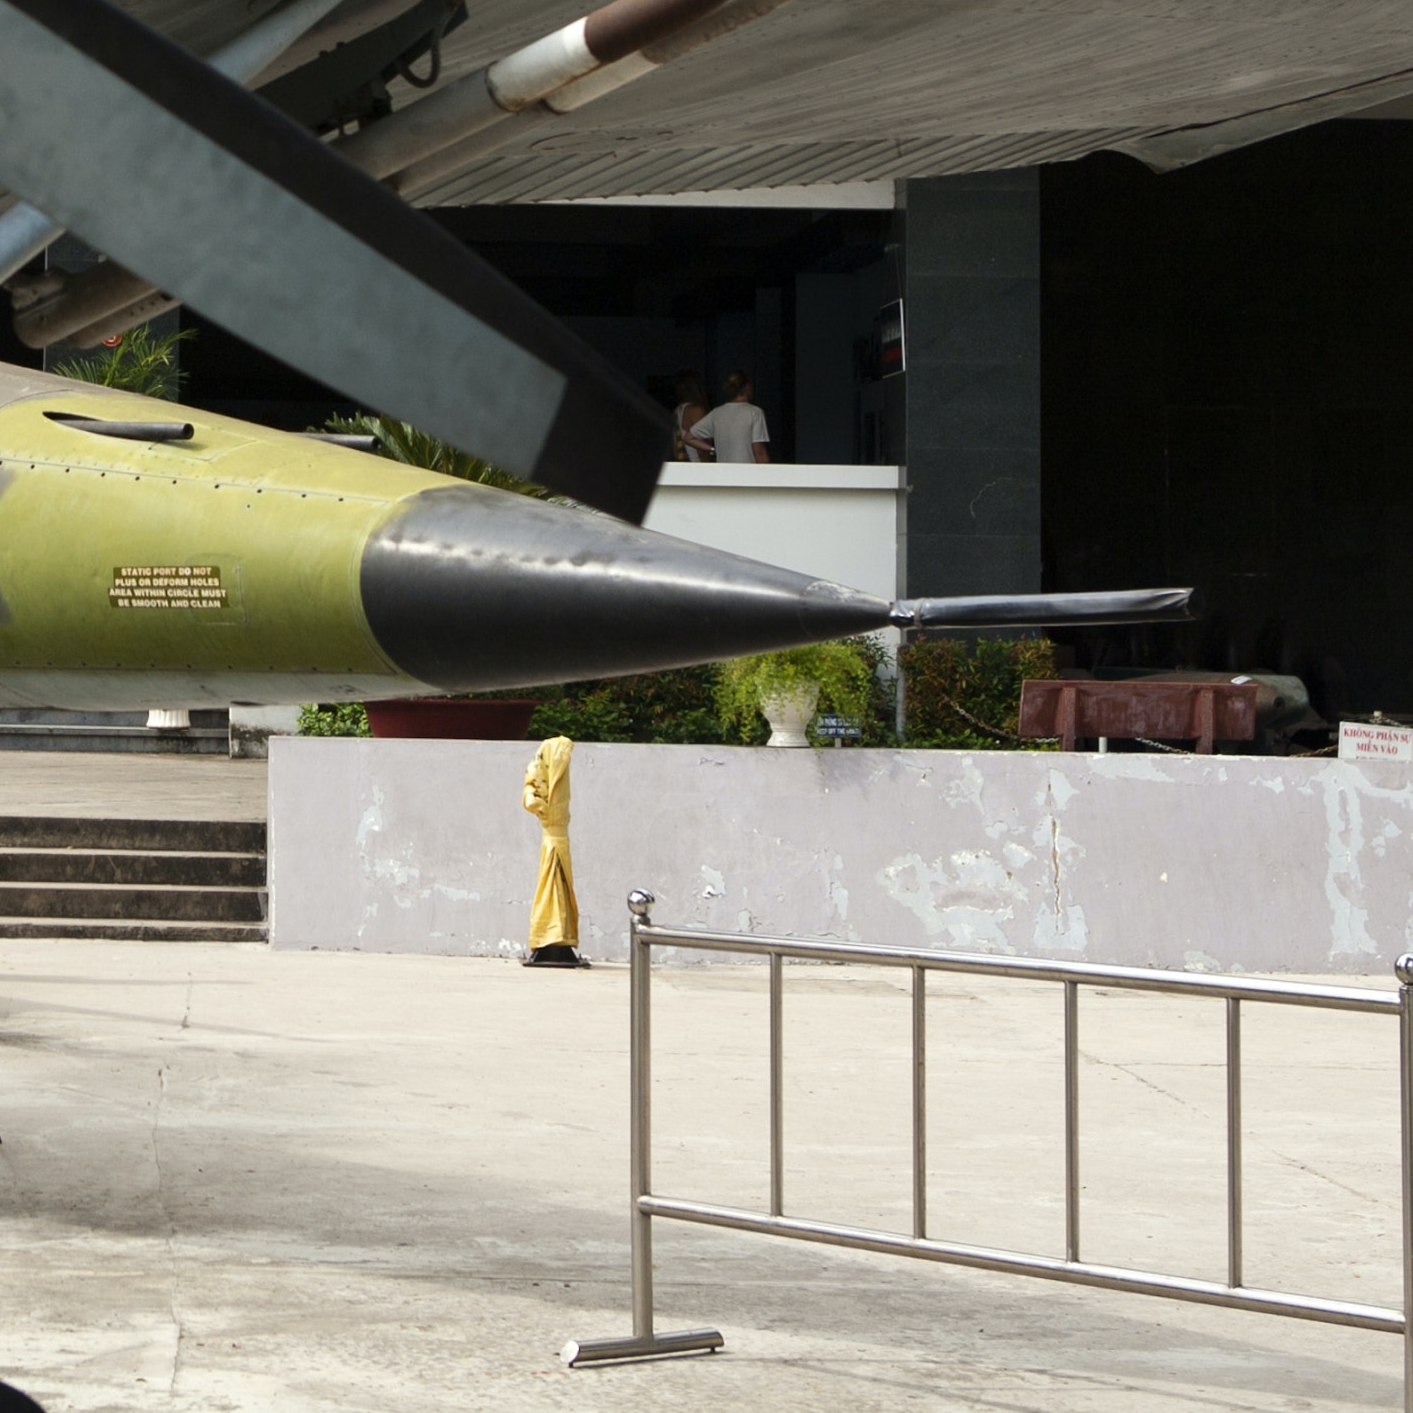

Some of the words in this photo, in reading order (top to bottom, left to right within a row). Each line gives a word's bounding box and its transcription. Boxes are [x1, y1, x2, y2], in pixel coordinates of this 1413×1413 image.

[121, 567, 152, 576] STATIC
[153, 567, 177, 576] PORT
[178, 567, 191, 576] DO
[192, 567, 212, 576] NOT
[138, 578, 151, 587] OR
[152, 578, 189, 587] DEFORM
[190, 578, 220, 587] HOLES
[109, 588, 133, 596] AREA
[133, 588, 166, 597] WITHIN
[167, 588, 200, 598] CIRCLE
[201, 589, 227, 598] MUST
[117, 598, 130, 607] BE
[131, 598, 169, 608] SMOOTH
[170, 599, 189, 608] AND
[190, 599, 222, 608] CLEAN
